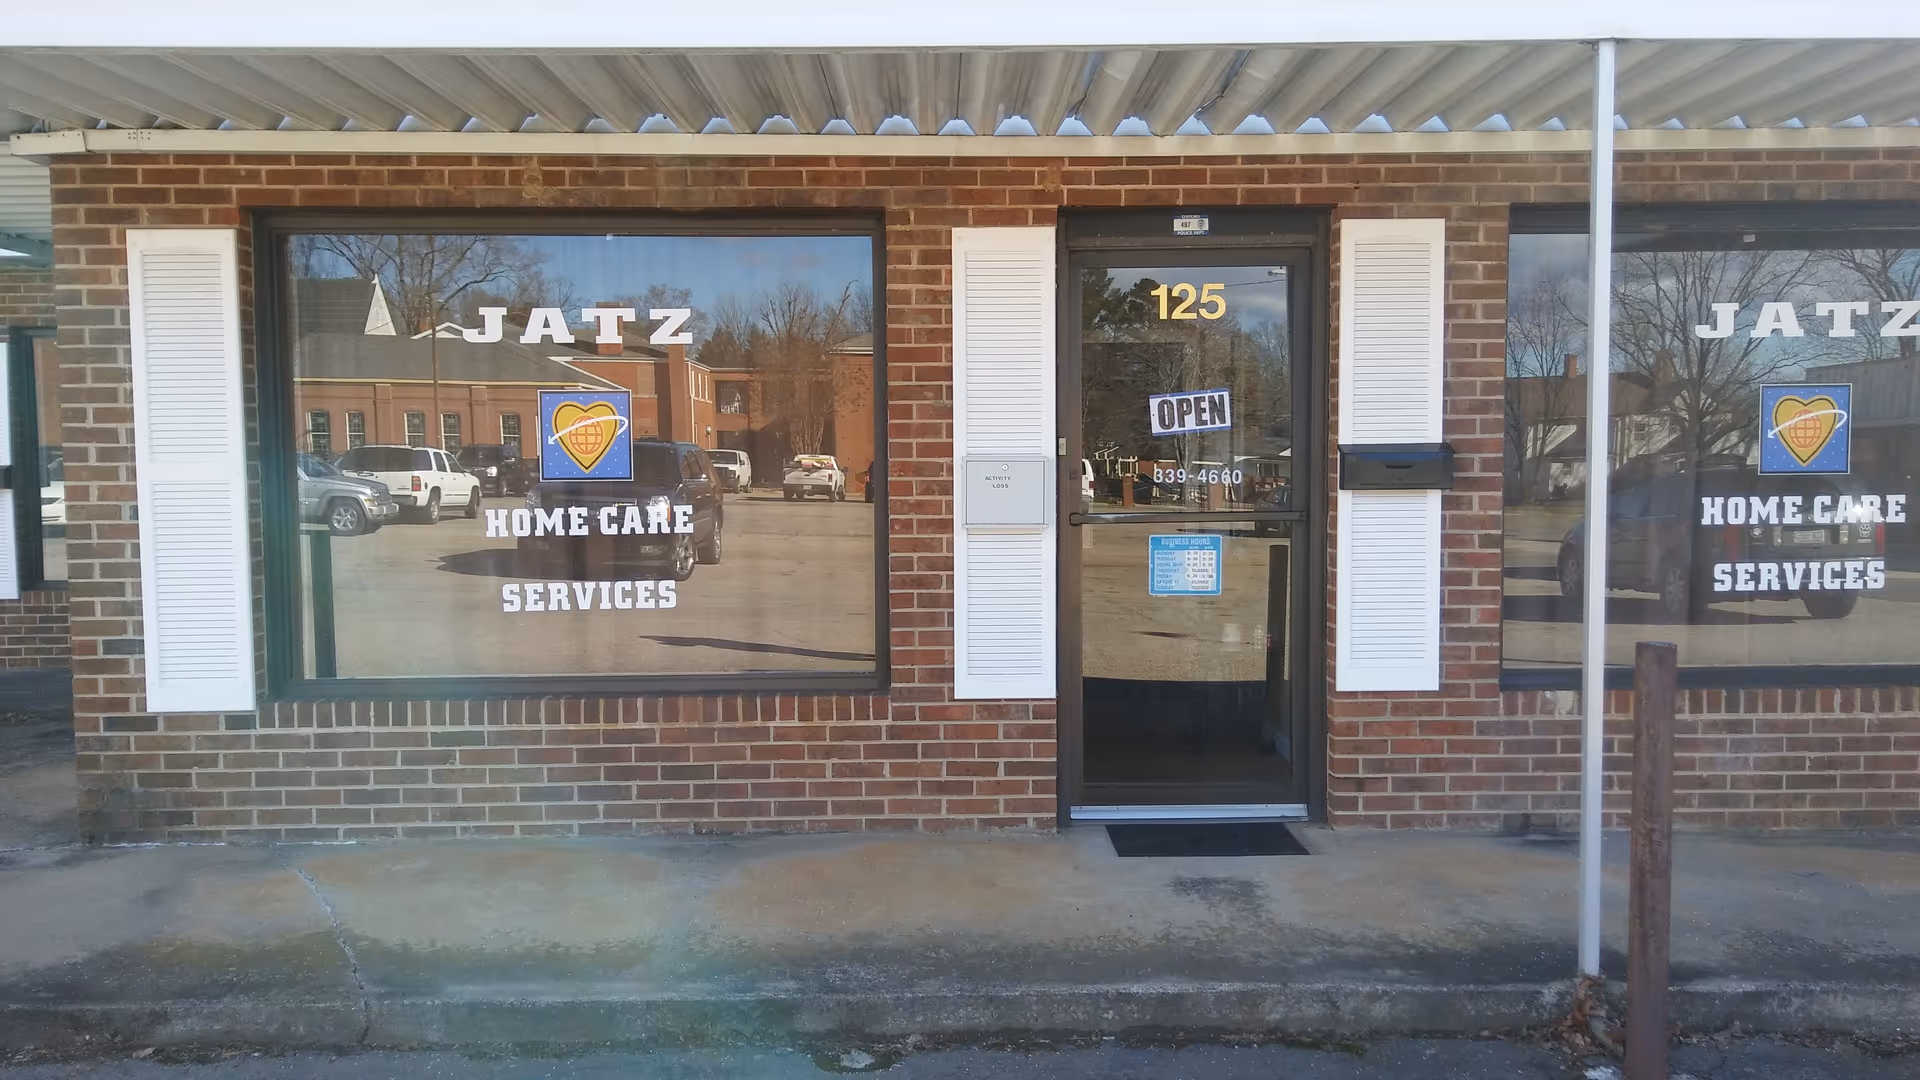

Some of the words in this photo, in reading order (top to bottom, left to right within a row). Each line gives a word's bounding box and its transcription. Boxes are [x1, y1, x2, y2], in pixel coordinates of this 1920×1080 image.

[1150, 283, 1226, 320] 125
[462, 306, 693, 345] JATZ
[1695, 300, 1920, 339] JATZ
[1156, 394, 1227, 431] OPEN
[485, 506, 589, 538] HOME
[599, 504, 694, 536] CARE
[1700, 495, 1802, 526] HOME
[1813, 493, 1906, 524] CARE
[1713, 560, 1886, 592] SERVICES
[502, 580, 677, 613] SERVICES
